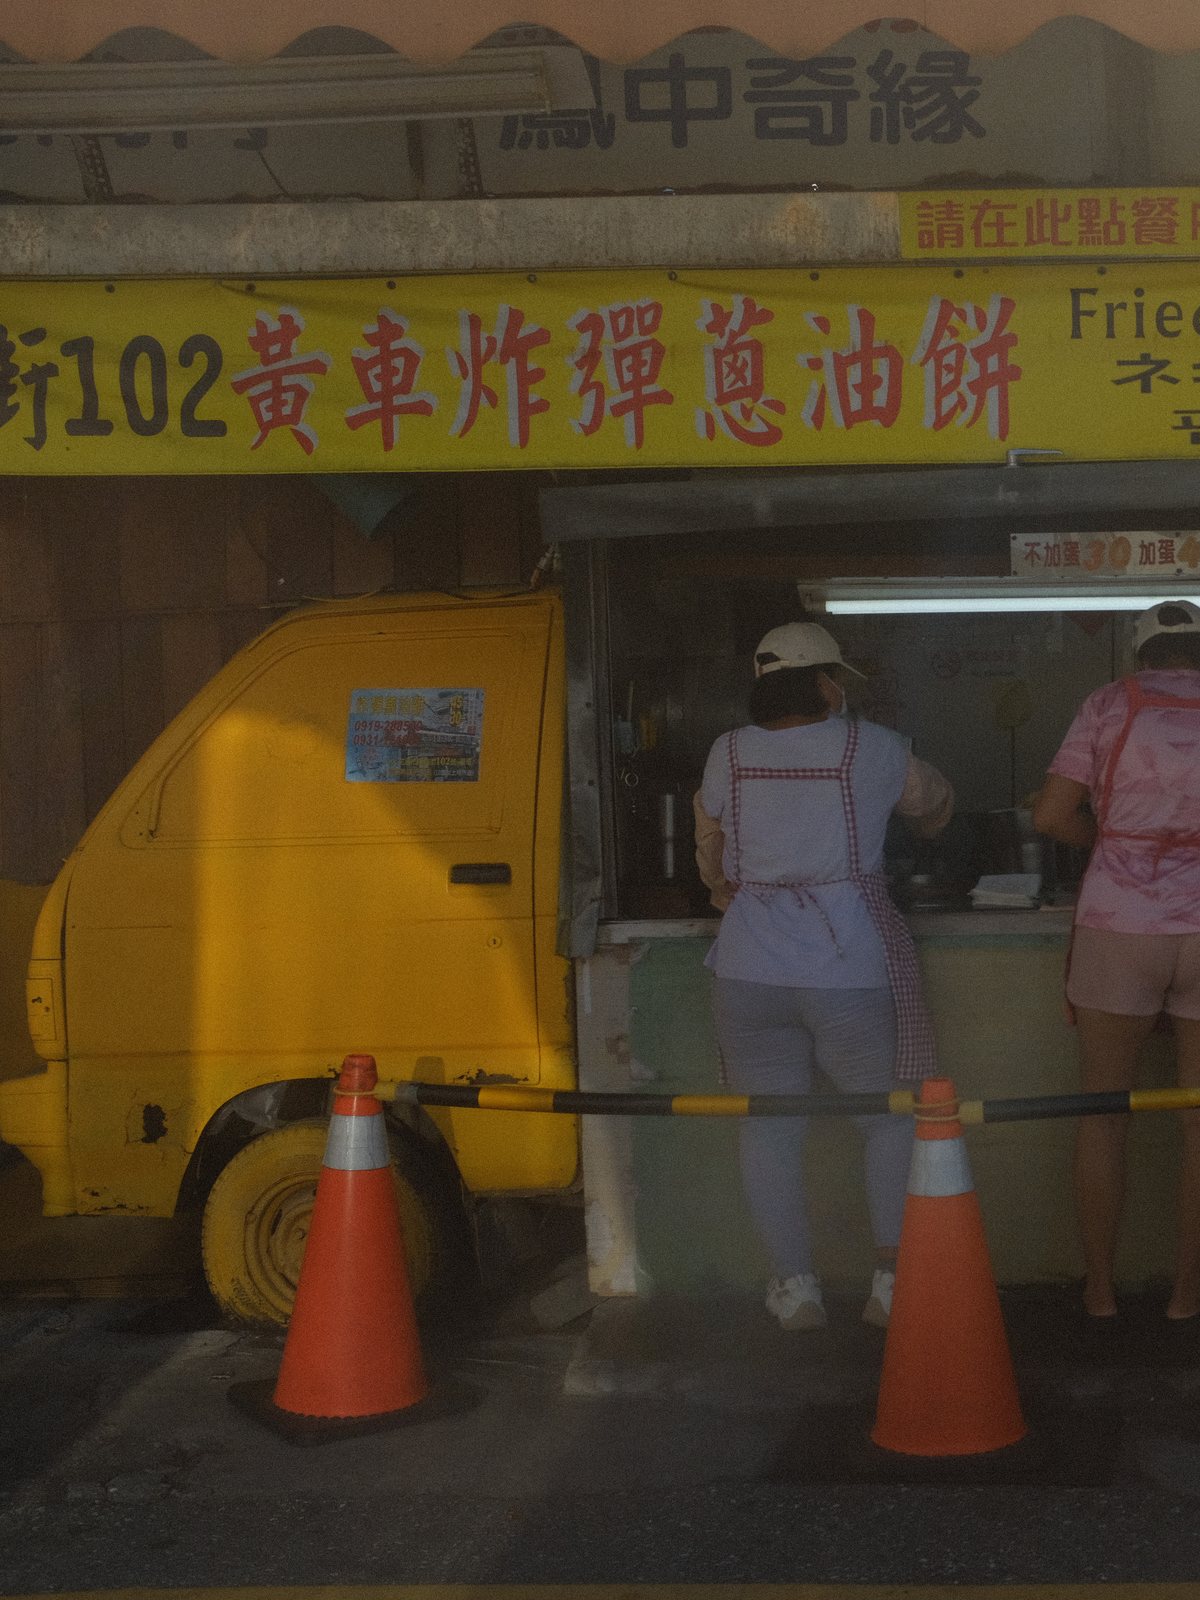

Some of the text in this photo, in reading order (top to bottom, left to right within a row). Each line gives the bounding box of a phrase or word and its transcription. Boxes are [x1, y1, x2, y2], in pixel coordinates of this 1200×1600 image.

[915, 196, 1179, 248] 請在此點餐
[1023, 535, 1132, 572] 不加蛋30
